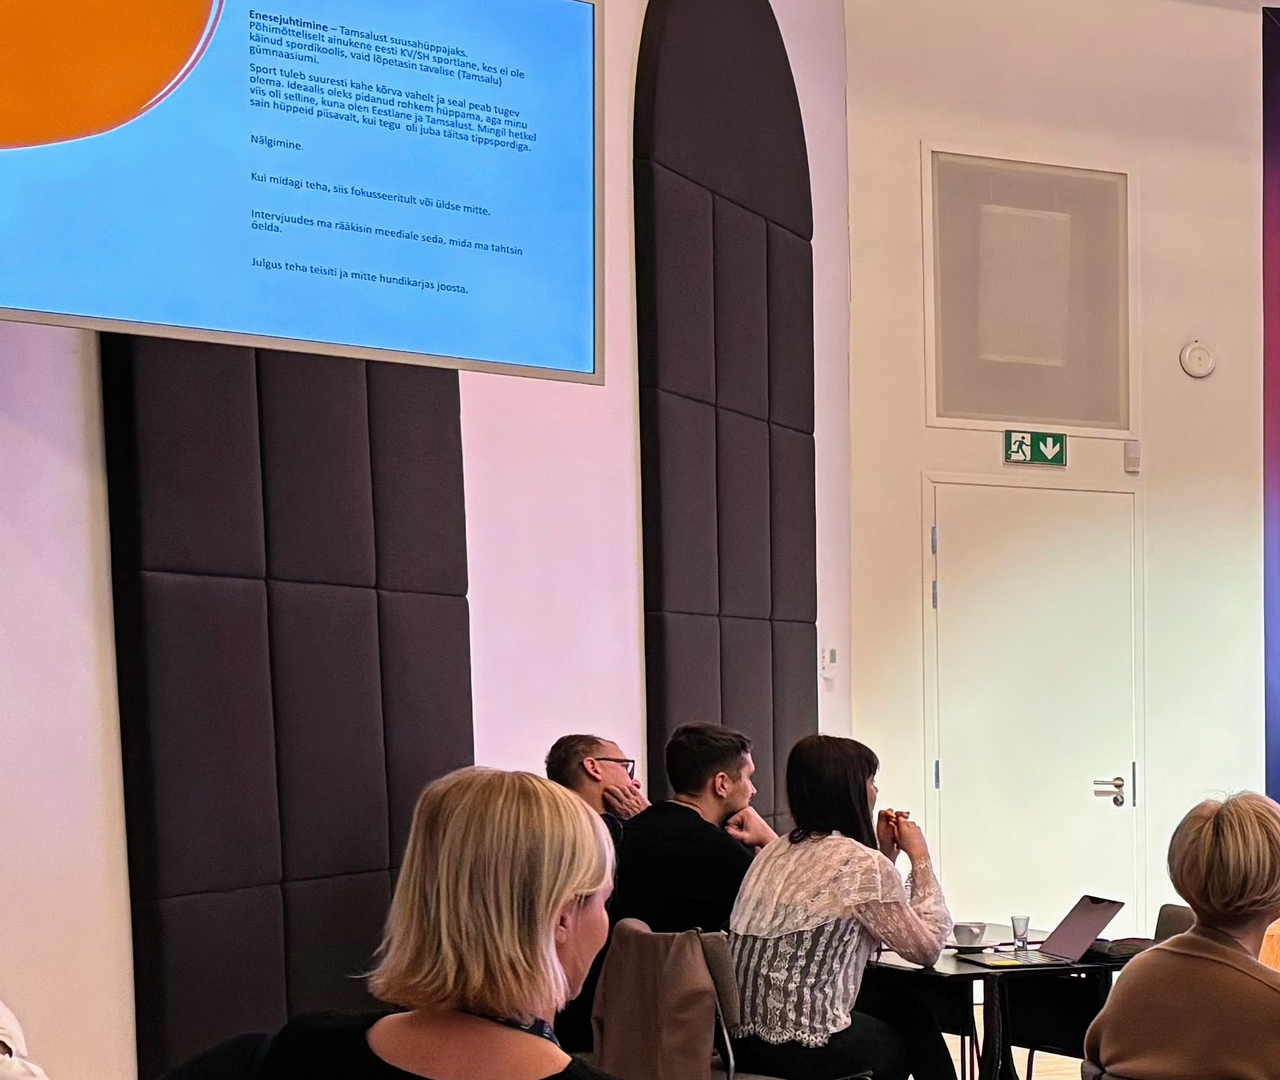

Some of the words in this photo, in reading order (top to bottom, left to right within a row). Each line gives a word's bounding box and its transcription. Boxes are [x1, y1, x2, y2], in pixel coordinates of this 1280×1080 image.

[248, 9, 328, 32] Enesejuhtimine
[339, 25, 388, 42] Tamsalust
[390, 36, 468, 57] suusahüppajaks.
[249, 20, 325, 42] Põhimõtteliselt
[327, 34, 372, 51] ainukene
[374, 44, 397, 55] eesti
[400, 47, 429, 61] KV/SH
[432, 55, 479, 71] sportlane,
[482, 61, 497, 73] kes
[499, 66, 508, 75] ei
[510, 68, 524, 78] ole
[249, 44, 319, 64] gümnaasiumi.
[249, 31, 282, 46] käinud
[285, 40, 347, 58] spordikoolis,
[349, 51, 370, 62] vaid
[372, 53, 417, 70] lõpetasin
[418, 63, 454, 77] tavalise
[457, 69, 502, 87] (Tamsalu)
[250, 134, 303, 150] Nälgimine.
[250, 172, 266, 182] Kui
[269, 176, 302, 189] midagi
[305, 180, 330, 192] teha,
[332, 184, 348, 194] siis
[350, 185, 417, 204] fokusseeritult
[418, 197, 433, 207] või
[435, 199, 461, 211] üldse
[462, 204, 490, 215] mitte.
[251, 220, 282, 232] õelda.
[251, 209, 314, 226] Intervjuudes
[316, 220, 332, 228] ma
[334, 220, 372, 233] rääkisin
[374, 228, 418, 240] meediale
[420, 234, 446, 245] seda,
[448, 238, 472, 248] mida
[474, 242, 488, 250] ma
[491, 243, 522, 255] tahtsin
[251, 257, 282, 270] Julgus
[284, 262, 307, 272] teha
[309, 265, 336, 276] teisiti
[339, 268, 348, 279] ja
[350, 271, 377, 281] mitte
[379, 273, 434, 290] hundikarjas
[437, 281, 468, 293] joosta.
